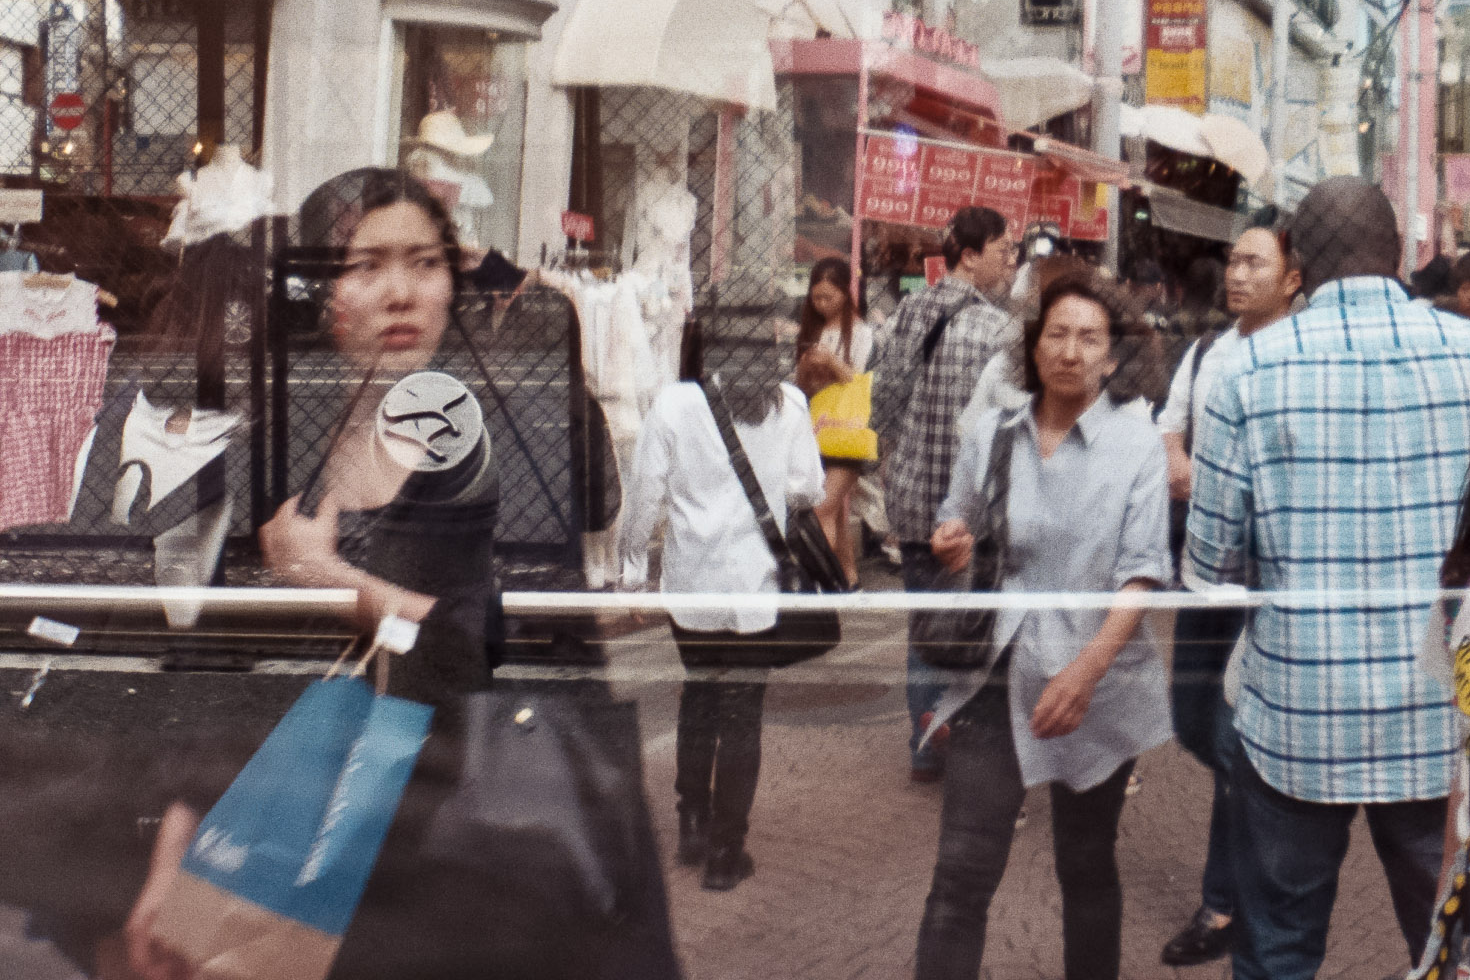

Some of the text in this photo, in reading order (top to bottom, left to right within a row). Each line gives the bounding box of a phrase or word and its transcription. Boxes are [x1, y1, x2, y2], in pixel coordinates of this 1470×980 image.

[929, 167, 971, 183] 990
[866, 196, 909, 214] 990
[922, 205, 957, 222] 99
